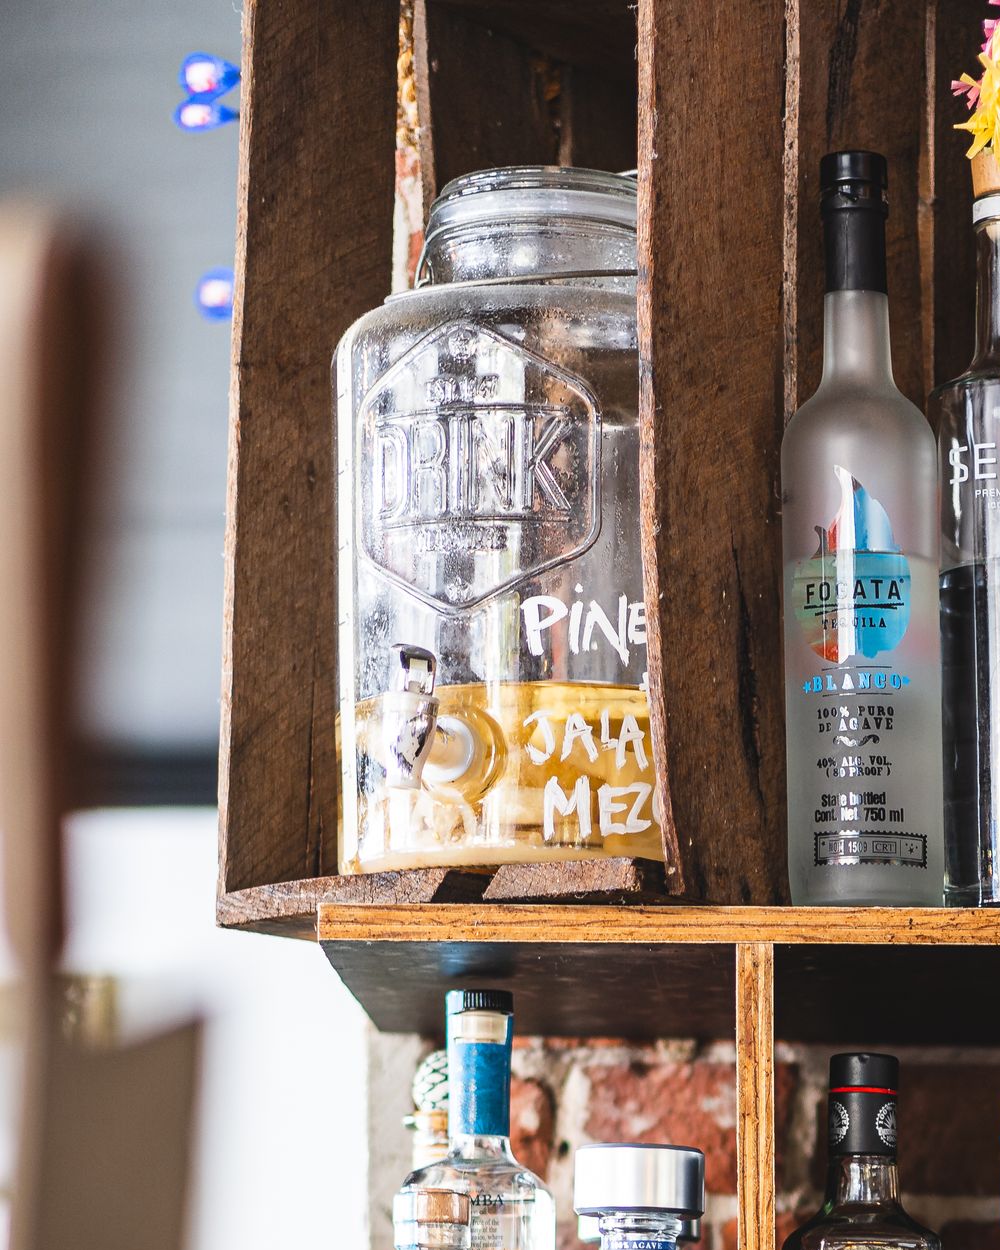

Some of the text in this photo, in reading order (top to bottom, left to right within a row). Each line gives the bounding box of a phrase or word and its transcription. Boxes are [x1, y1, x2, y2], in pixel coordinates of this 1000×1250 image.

[376, 413, 575, 520] DRINK
[806, 578, 902, 604] FOGATA
[821, 617, 887, 630] TEQUILA
[812, 672, 902, 693] BLANCO
[817, 705, 895, 720] 100% PURO
[818, 717, 894, 733] DE AGAVE
[816, 755, 893, 769] 40% ALC. VOL.
[849, 791, 887, 806] bottled
[814, 807, 904, 823] Cont. 750 ml
[828, 840, 845, 855] NOM
[874, 842, 896, 852] CRT
[631, 1240, 663, 1250] AGAVE
